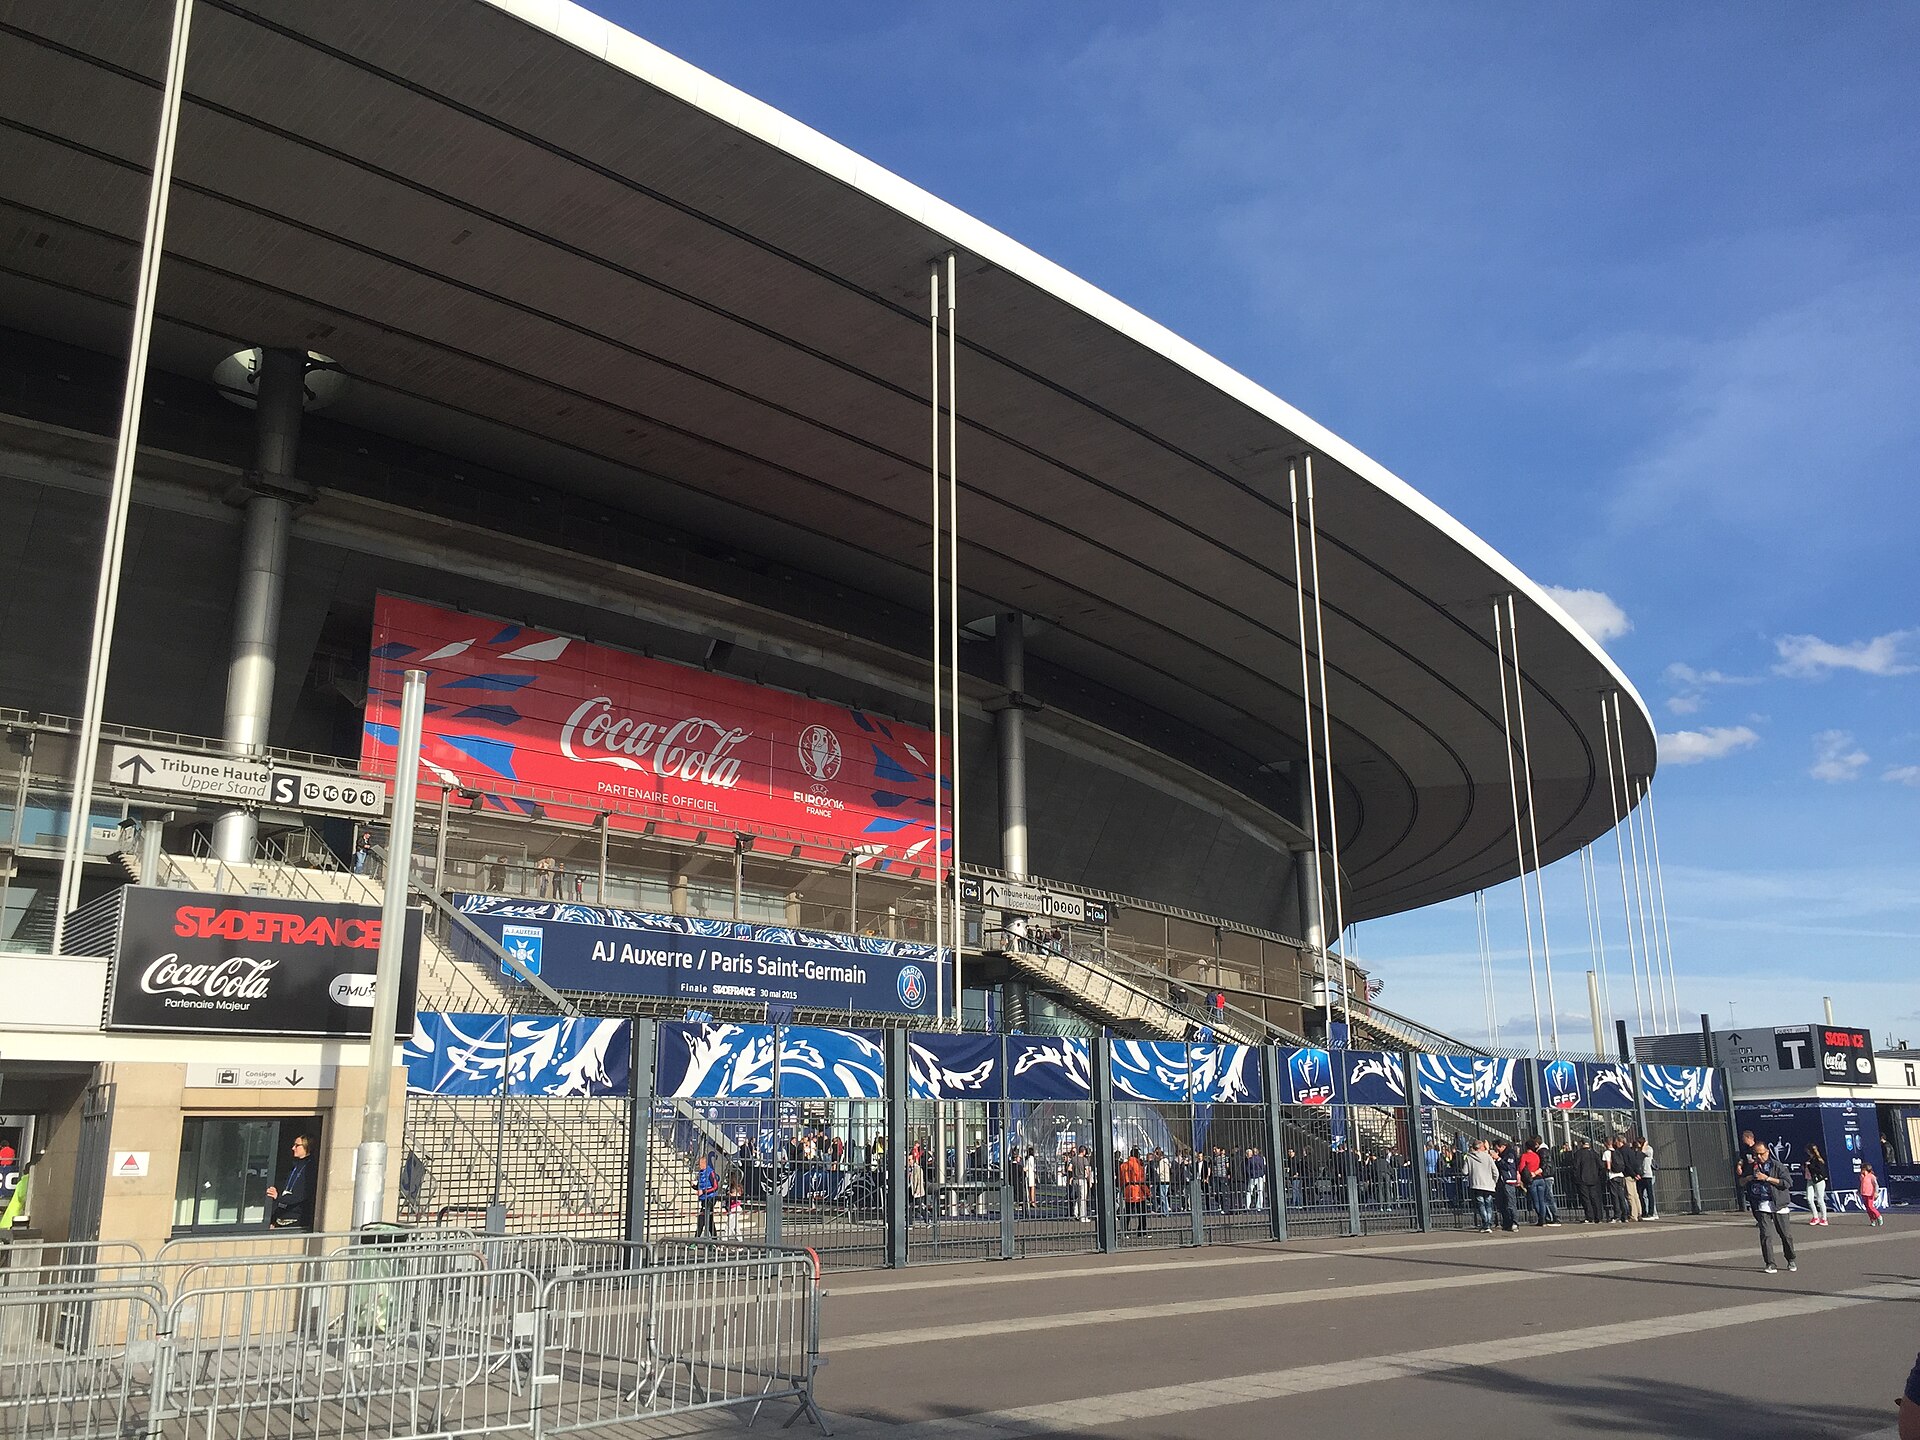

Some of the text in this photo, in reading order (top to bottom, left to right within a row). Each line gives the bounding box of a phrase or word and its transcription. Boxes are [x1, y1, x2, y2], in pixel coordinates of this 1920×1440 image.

[560, 696, 754, 791] Coca-Cola
[160, 757, 268, 783] Tribune Haute
[181, 775, 267, 797] Upper Stand
[275, 778, 294, 804] S
[304, 785, 375, 804] 15 16 17 18
[597, 781, 720, 812] PARTENAIRE OFFICIEL
[806, 806, 832, 818] FRANCE
[1000, 887, 1040, 902] Tribune Haute
[1042, 897, 1052, 915] U
[174, 905, 382, 949] STADEFRANCE
[592, 941, 867, 984] AJ Auxerre / Paris Saint-Germain
[140, 953, 280, 999] Coca-Cola
[902, 967, 921, 979] PARIS
[337, 985, 368, 997] PMU
[680, 983, 708, 993] Finale
[760, 989, 769, 998] 30
[769, 990, 781, 998] mai
[782, 990, 798, 1000] 2015
[164, 998, 251, 1012] Partenaire Majeur
[1782, 1040, 1806, 1070] T
[245, 1070, 277, 1078] Consigne
[1298, 1085, 1330, 1102] FFF
[1553, 1092, 1577, 1106] FFF
